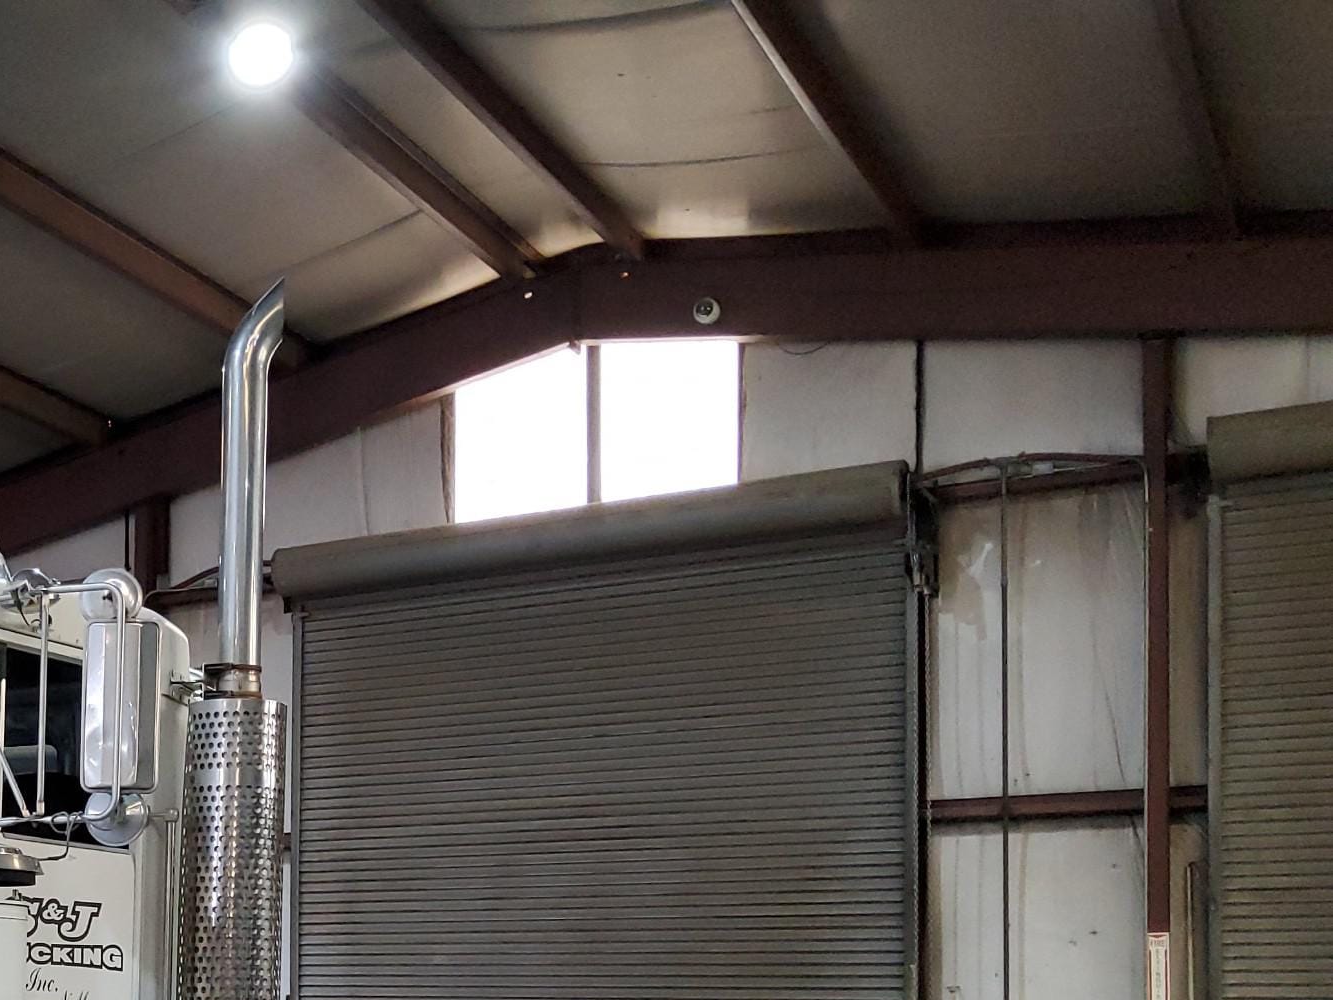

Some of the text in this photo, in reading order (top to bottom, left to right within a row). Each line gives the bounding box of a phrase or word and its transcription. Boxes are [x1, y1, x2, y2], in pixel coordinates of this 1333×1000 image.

[23, 897, 102, 943] &J
[26, 941, 124, 972] CKING
[25, 967, 59, 992] Inc.
